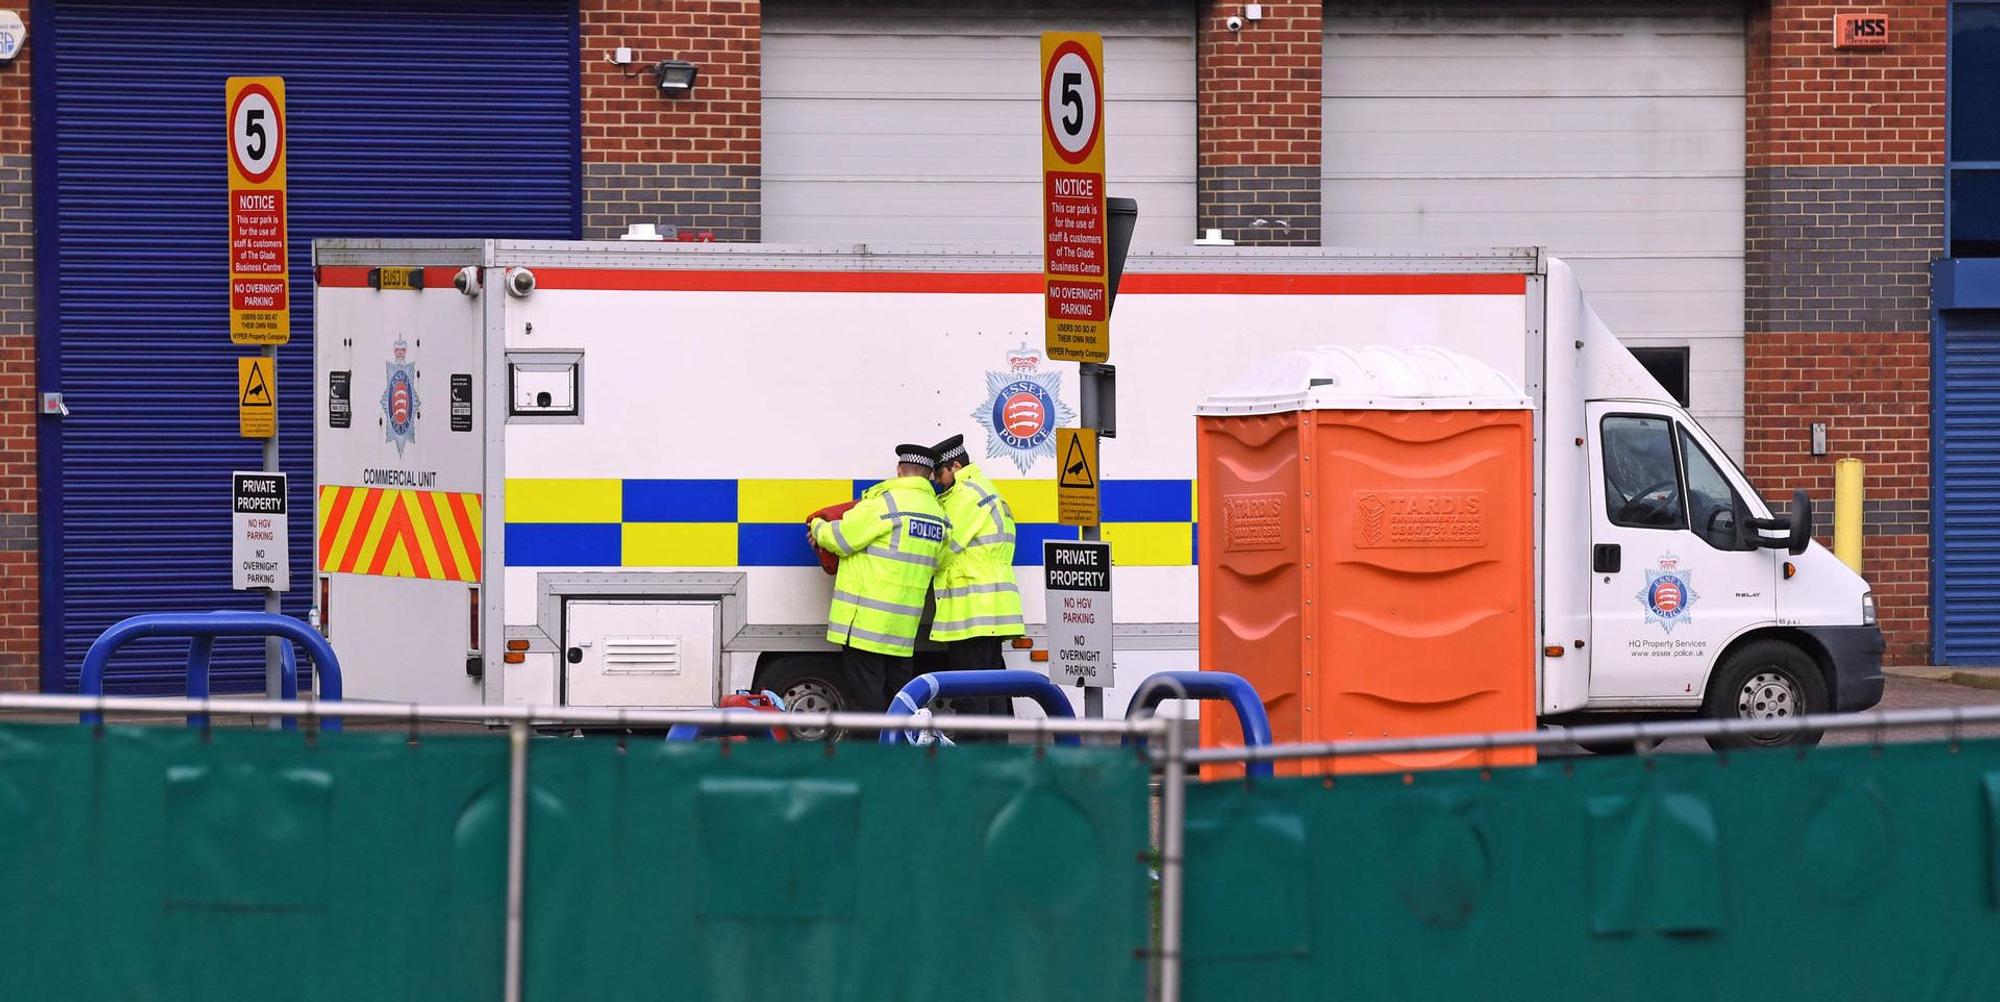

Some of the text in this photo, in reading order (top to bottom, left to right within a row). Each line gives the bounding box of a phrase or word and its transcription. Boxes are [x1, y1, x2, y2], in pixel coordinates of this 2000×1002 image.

[1854, 19, 1885, 36] HSS
[1062, 73, 1083, 136] 5
[246, 110, 266, 160] 5
[1055, 178, 1093, 196] NOTICE
[239, 195, 275, 209] NOTICE
[1052, 202, 1098, 216] This car park is
[237, 215, 279, 226] This car park is
[1055, 216, 1095, 229] for the use of
[240, 227, 277, 236] for the use of
[1049, 231, 1102, 244] staff & customers
[234, 239, 283, 248] staff & customers
[240, 250, 276, 260] of The Glade
[1056, 246, 1094, 259] of The Glade
[235, 262, 282, 272] Business Centre
[1051, 260, 1100, 273] Business Centre
[234, 283, 284, 294] NO OVERNIGHT
[1050, 286, 1103, 300] NO OVERNIGHT
[244, 296, 274, 307] PARKING
[1060, 303, 1092, 316] PARKING
[1057, 323, 1097, 334] USERS DO SO AT
[1057, 334, 1097, 344] THEIR OWN RISK
[1065, 348, 1085, 358] Property
[1085, 349, 1107, 359] Company
[1002, 382, 1046, 400] ESSEX
[999, 428, 1050, 449] POLICE
[363, 468, 436, 487] COMMERCIAL UNIT
[242, 479, 276, 494] PRIVATE
[237, 496, 282, 511] PROPERTY
[1390, 495, 1480, 514] TARDIS
[248, 519, 271, 528] NO HGV
[909, 520, 942, 540] POLICE
[246, 531, 273, 541] PARKING
[256, 549, 265, 559] NO
[1055, 549, 1098, 566] PRIVATE
[242, 561, 278, 571] OVERNIGHT
[246, 573, 275, 584] PARKING
[1050, 570, 1105, 587] PROPERTY
[1064, 598, 1092, 609] NO HGV
[1652, 605, 1683, 617] POLICE
[1062, 612, 1095, 624] PARKING
[1074, 635, 1085, 646] NO
[1628, 639, 1707, 649] HQ Property Services
[1059, 649, 1101, 662] OVERNIGHT
[1065, 664, 1096, 677] PARKING
